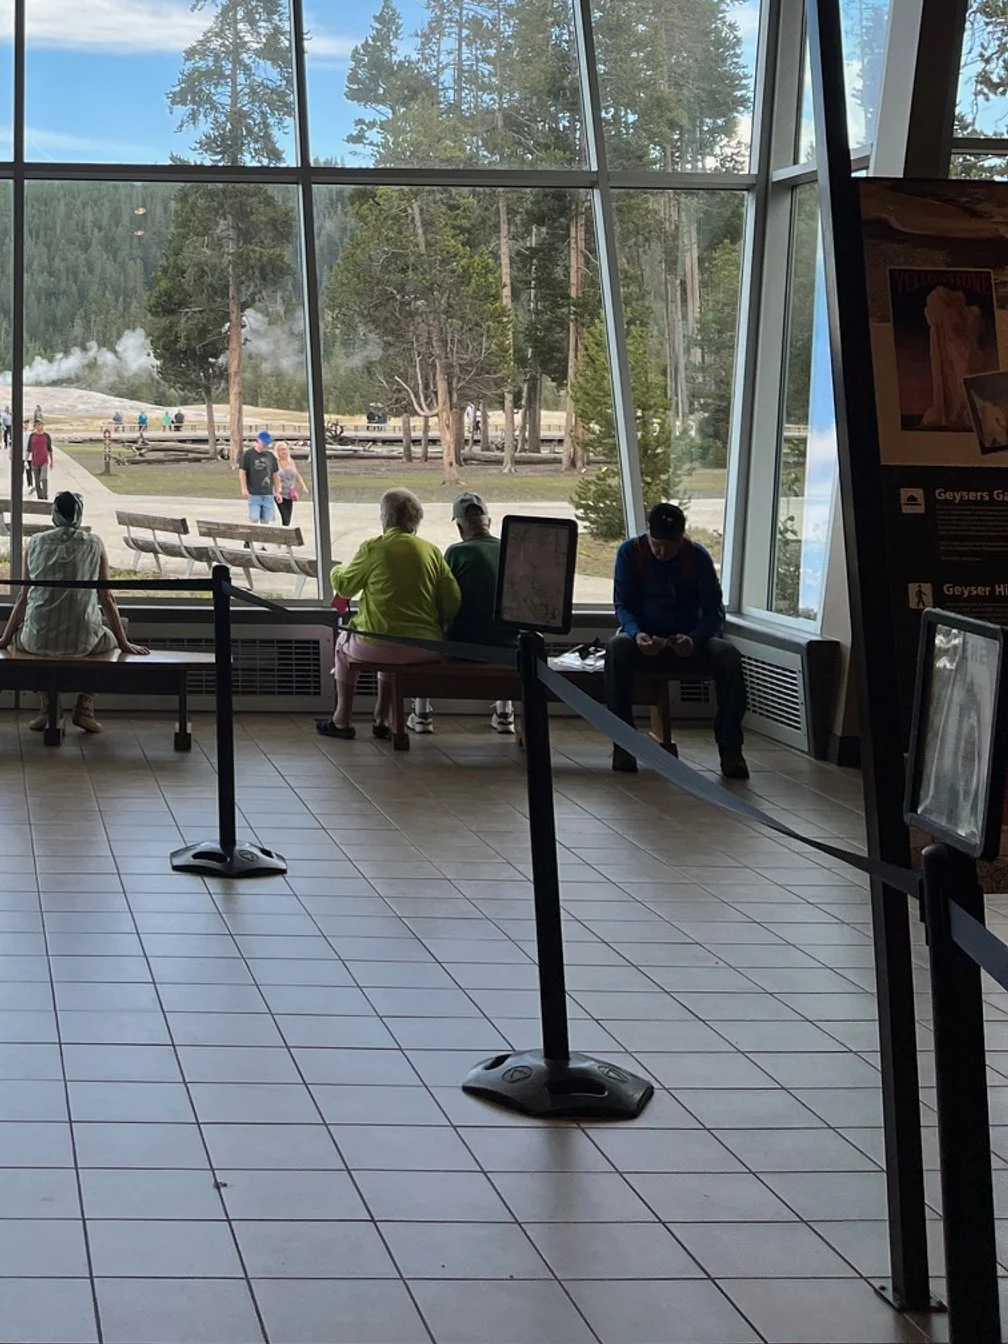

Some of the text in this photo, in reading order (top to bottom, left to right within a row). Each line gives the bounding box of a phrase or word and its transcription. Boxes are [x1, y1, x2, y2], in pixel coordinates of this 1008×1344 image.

[893, 270, 991, 294] YELLOWSTONE
[934, 487, 990, 503] Geysers
[943, 583, 992, 598] Geyser
